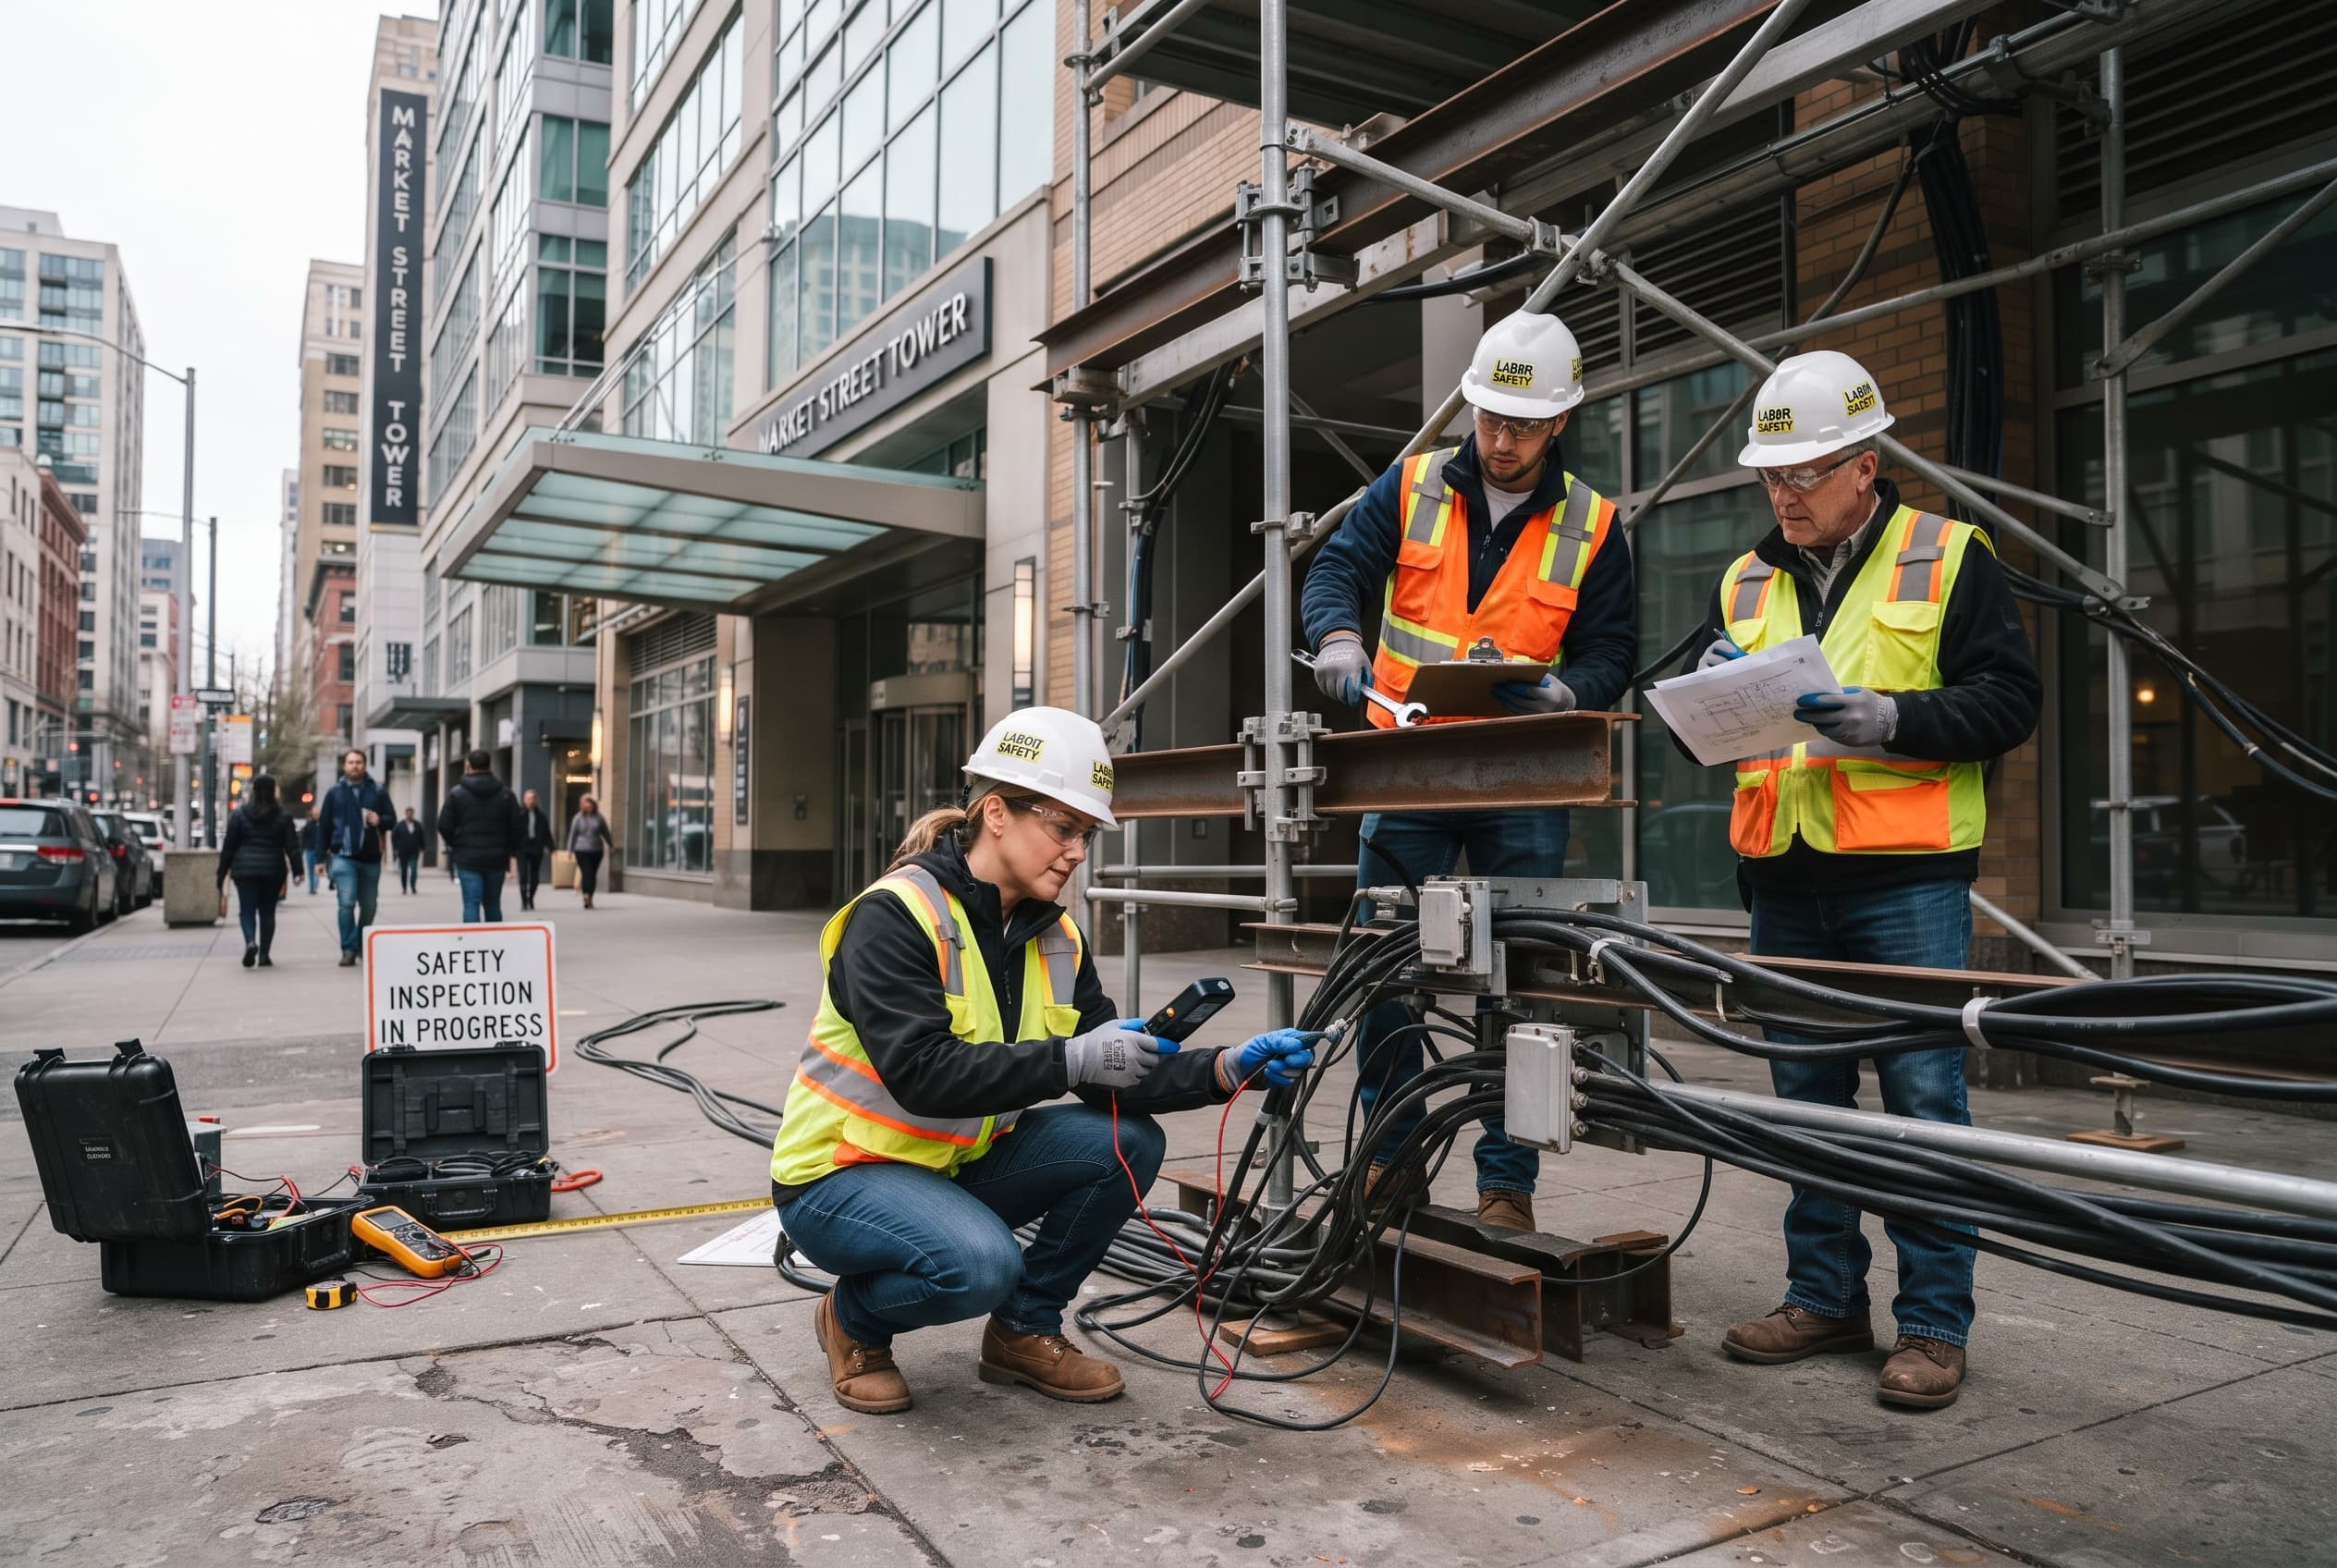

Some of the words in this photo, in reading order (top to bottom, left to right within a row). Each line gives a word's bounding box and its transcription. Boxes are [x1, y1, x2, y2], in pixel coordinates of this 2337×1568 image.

[392, 104, 415, 232] MARKET
[388, 246, 409, 373] STREET
[819, 348, 886, 422] STREET
[887, 291, 967, 377] TOWER
[1493, 372, 1533, 386] SAFETY
[381, 400, 410, 508] TOWER
[997, 741, 1040, 761] SAFETY
[416, 949, 505, 975] SAFETY
[390, 980, 532, 1010] INSPECTION
[381, 1019, 404, 1044] IN
[417, 1012, 543, 1043] PROGRESS
